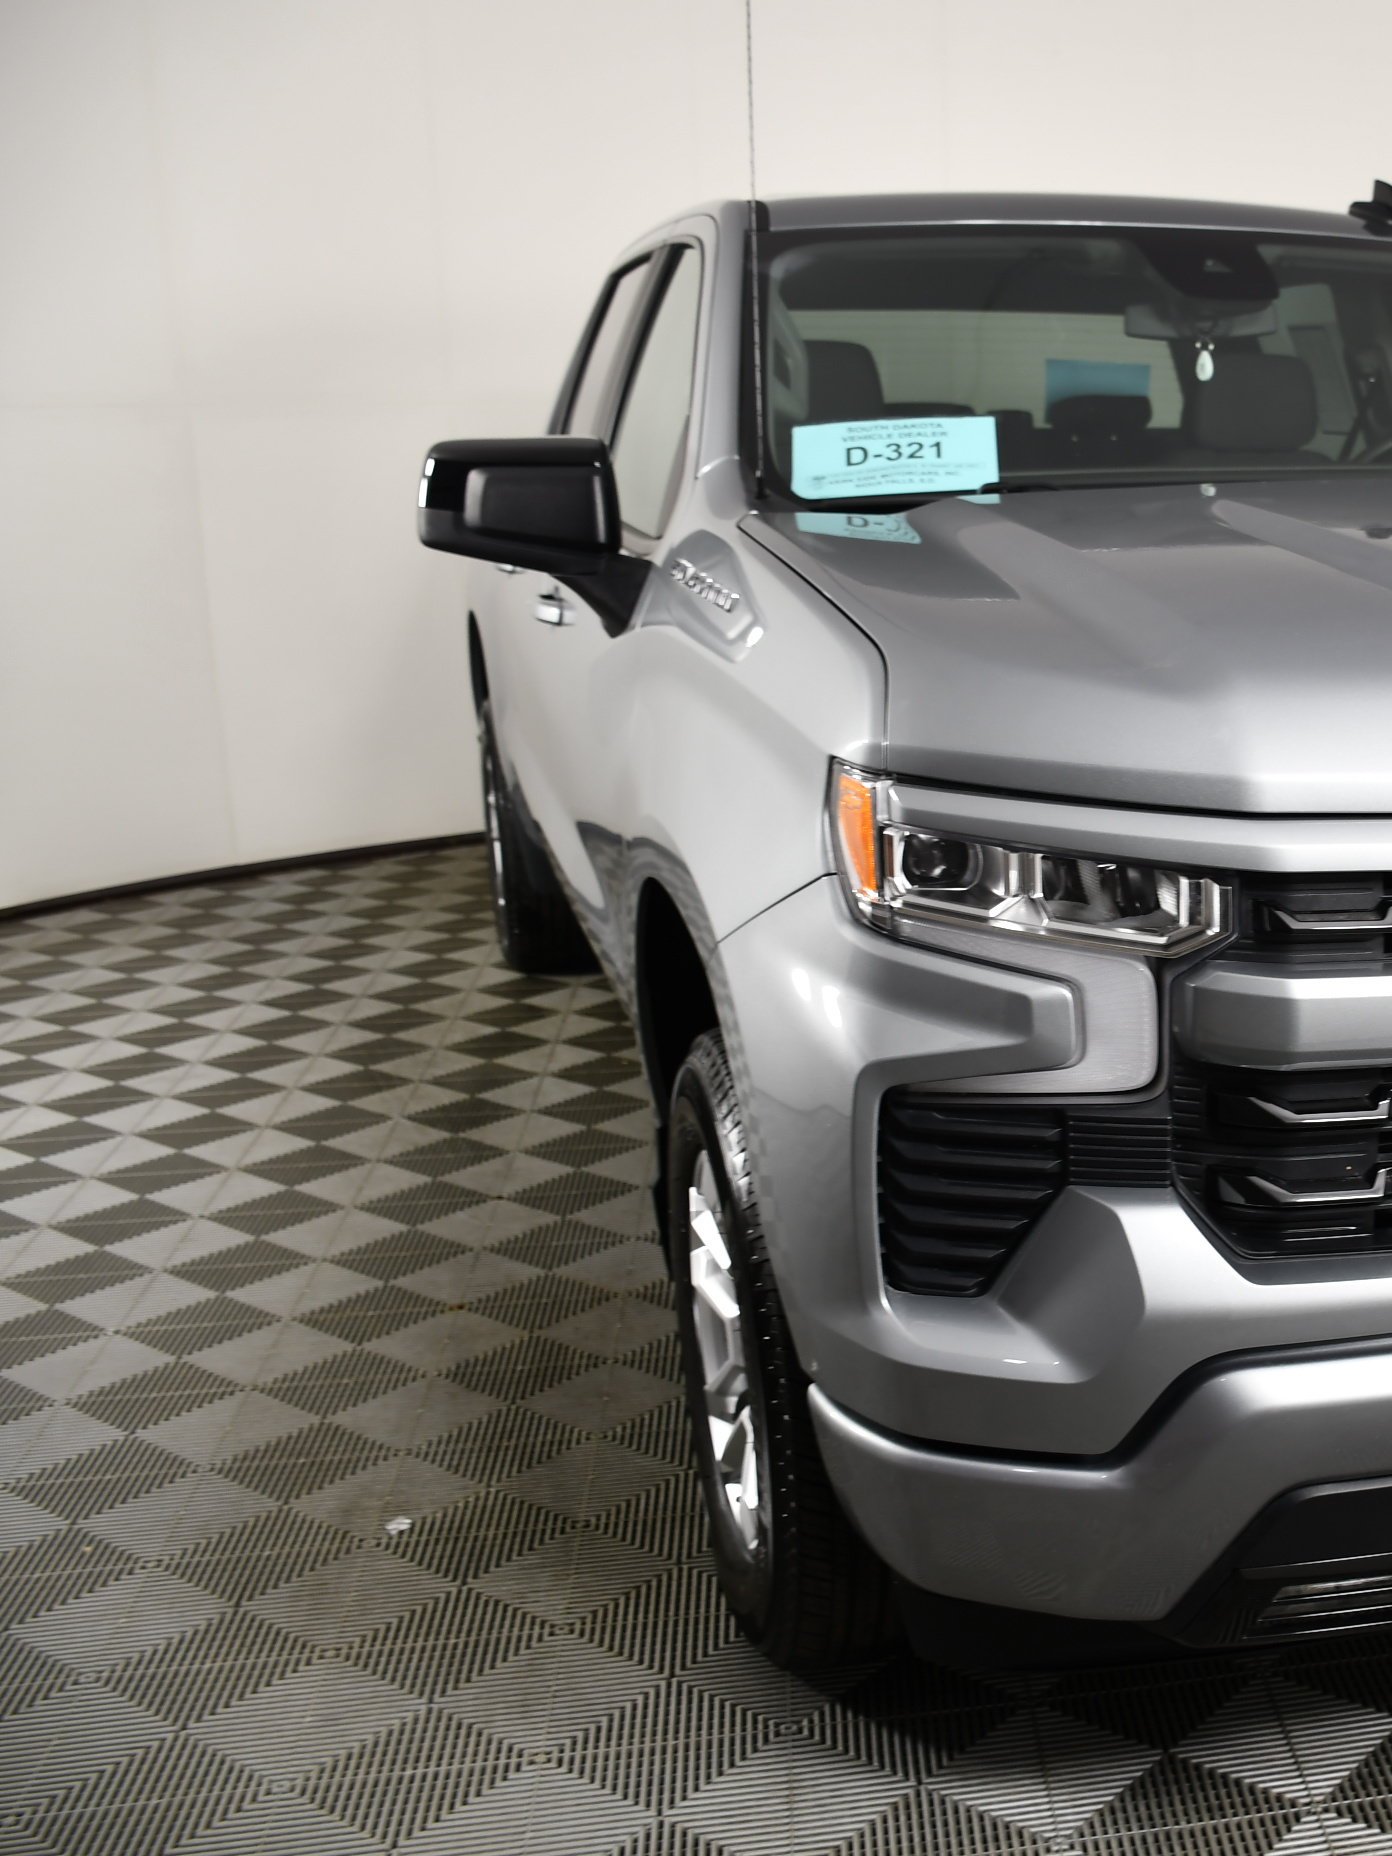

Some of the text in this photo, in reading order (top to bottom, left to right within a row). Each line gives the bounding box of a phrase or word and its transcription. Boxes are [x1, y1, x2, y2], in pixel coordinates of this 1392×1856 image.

[846, 422, 943, 433] SOUTH DAKOTA
[841, 431, 948, 442] VEHICLE DEALER
[846, 441, 942, 467] D-321
